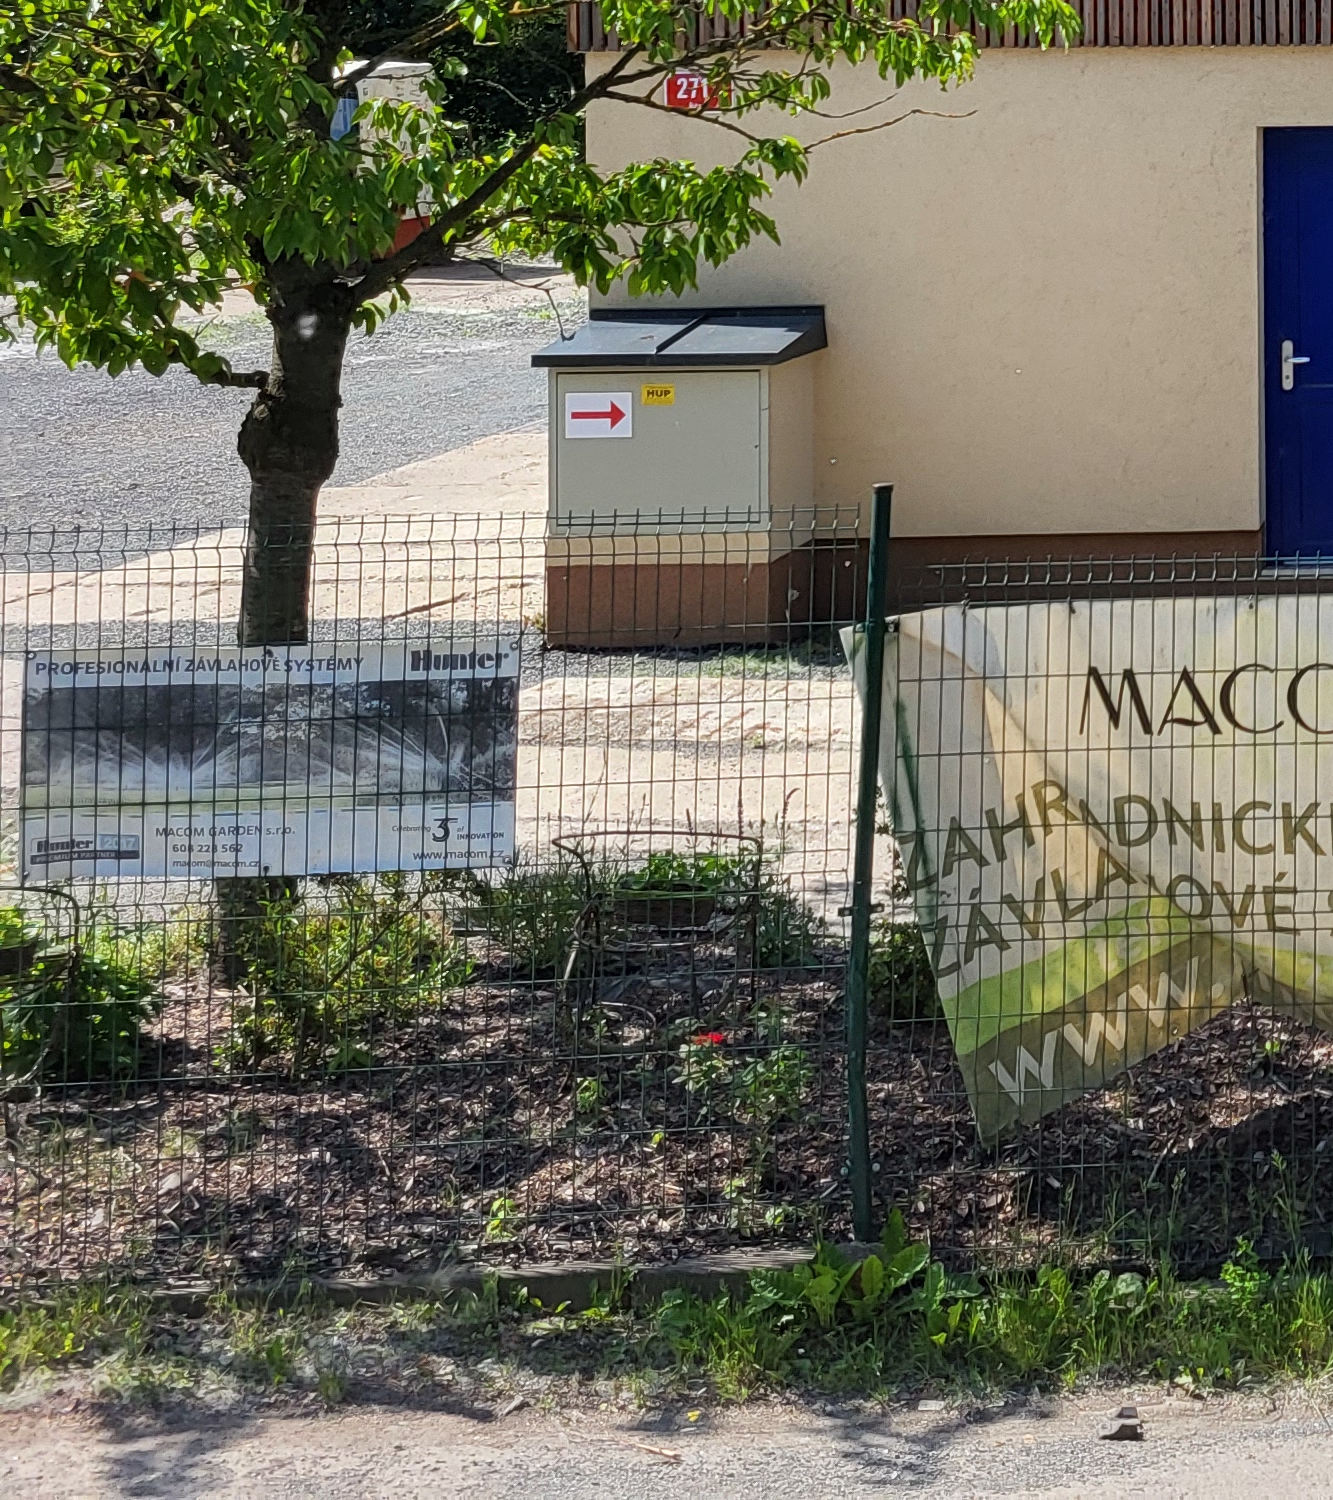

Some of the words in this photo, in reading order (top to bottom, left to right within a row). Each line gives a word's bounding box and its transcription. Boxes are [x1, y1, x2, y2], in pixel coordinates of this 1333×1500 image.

[646, 389, 672, 398] HUP
[35, 656, 181, 676] PROFESIONÁLNÍ
[184, 655, 281, 673] ZÁVLAHOVÉ
[284, 655, 364, 672] SYSTÉMY
[155, 826, 205, 838] MACOM
[208, 825, 262, 837] GARDEN
[391, 824, 432, 833] Celebratng
[456, 831, 505, 841] INNOVATON
[221, 843, 244, 853] 562
[930, 845, 1301, 980] ZÁVLAOVÉ
